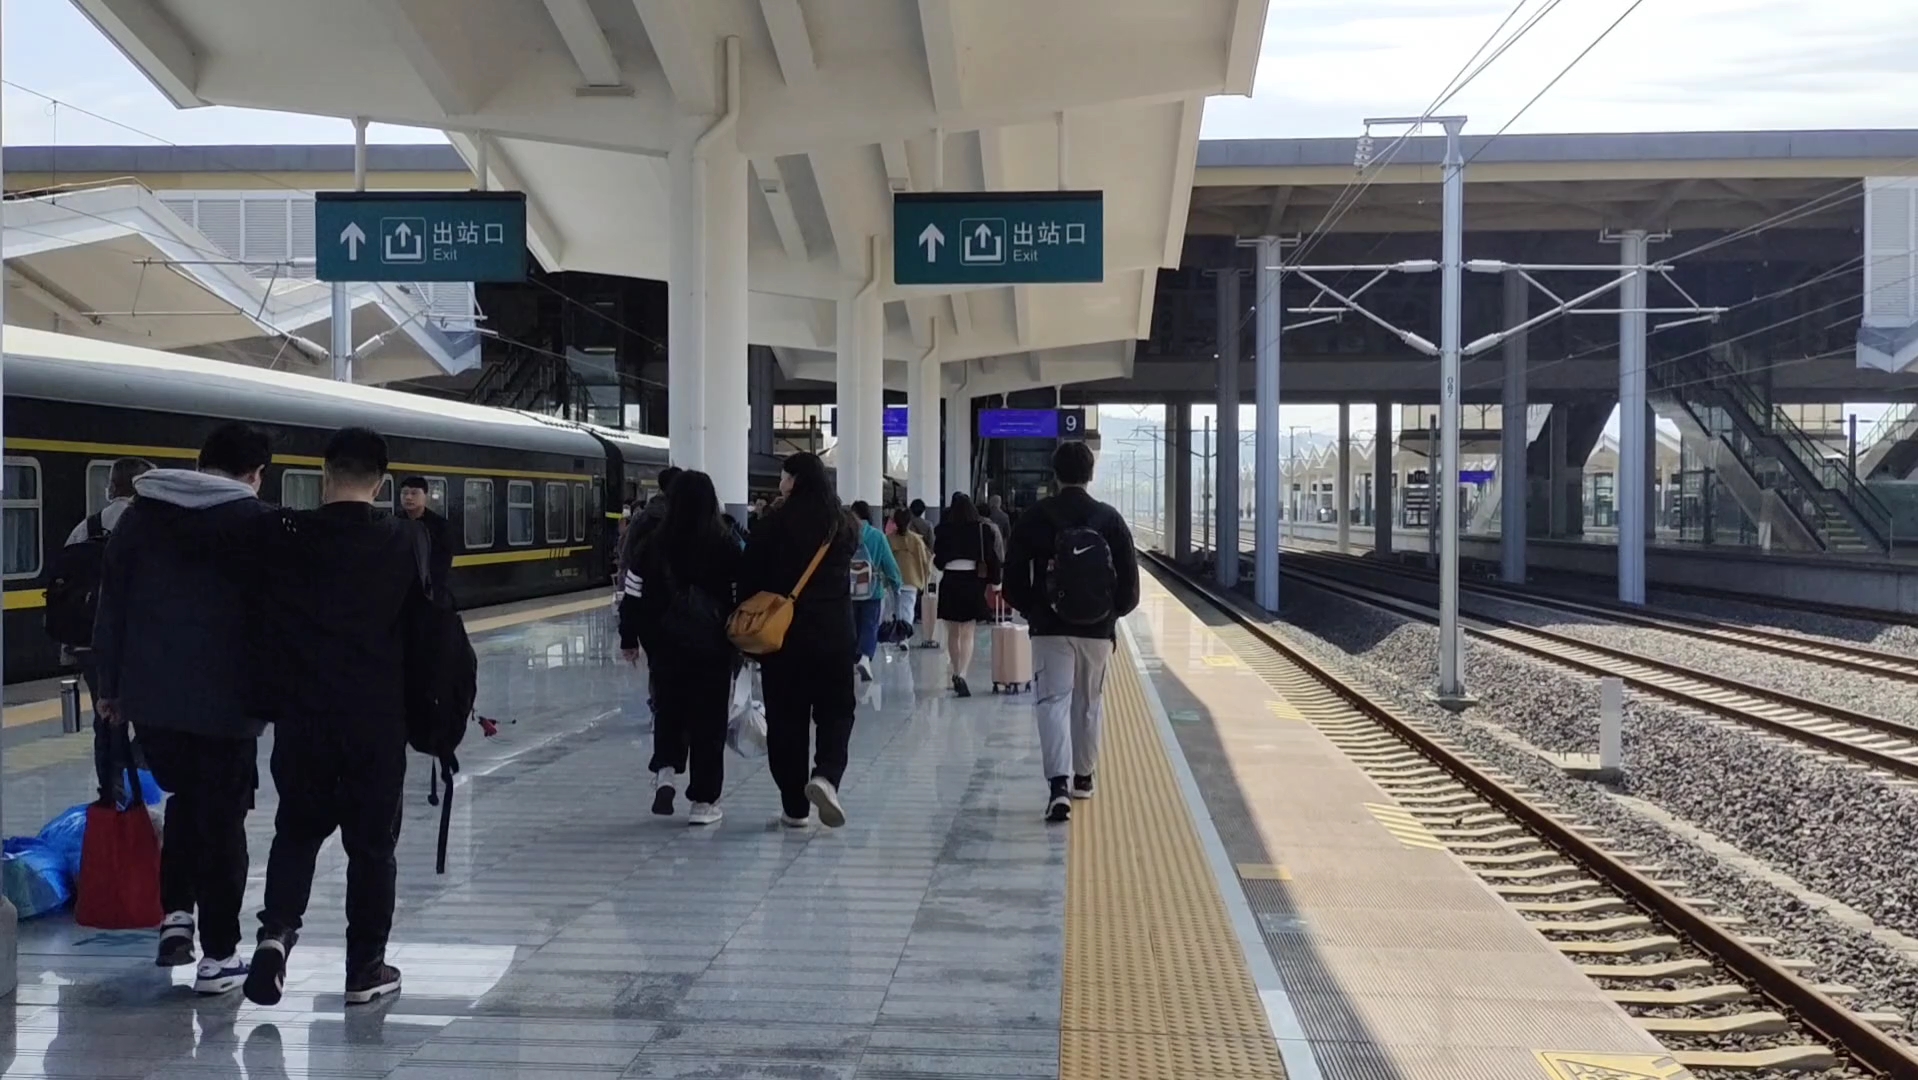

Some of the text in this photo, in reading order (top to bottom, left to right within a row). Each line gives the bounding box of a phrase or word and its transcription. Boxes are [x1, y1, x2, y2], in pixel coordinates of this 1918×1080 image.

[432, 220, 504, 245] 出站口
[1012, 220, 1086, 246] 出站口
[432, 248, 458, 261] Exit
[1012, 249, 1038, 262] Exit
[1065, 415, 1077, 431] 9
